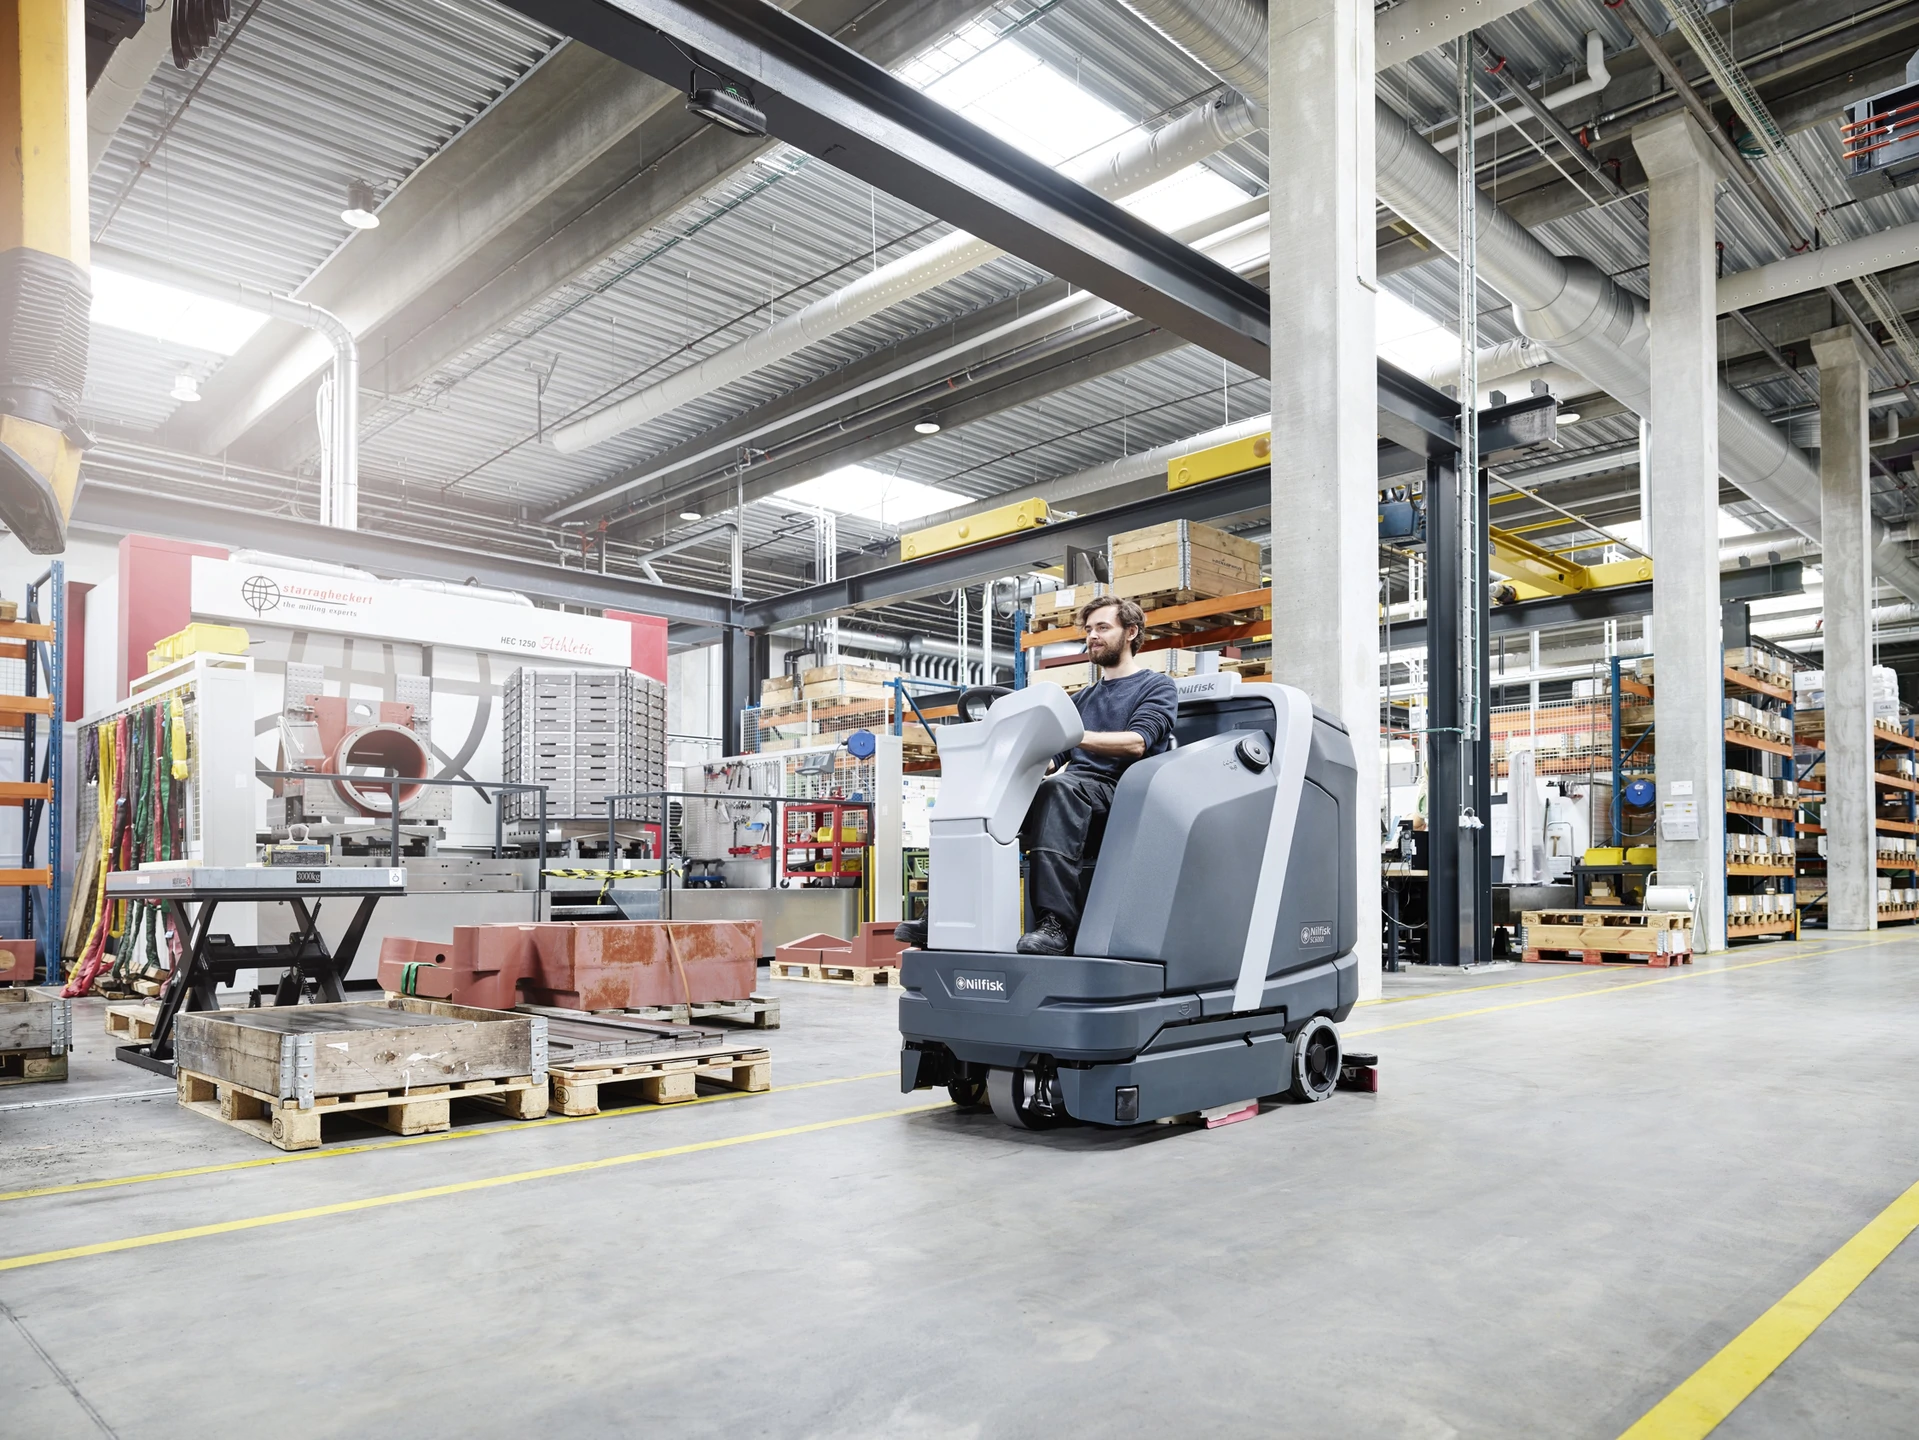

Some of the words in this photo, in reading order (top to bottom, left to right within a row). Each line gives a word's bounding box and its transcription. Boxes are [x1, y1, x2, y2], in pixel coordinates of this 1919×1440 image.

[283, 584, 373, 604] starragheckert
[283, 601, 296, 609] the
[299, 604, 326, 614] milling
[329, 608, 358, 617] experts
[500, 636, 516, 646] HEC
[519, 639, 537, 648] 1250
[540, 636, 594, 656] Athletic
[1178, 683, 1215, 694] Nilfisk
[297, 872, 321, 882] 3000kg
[1310, 926, 1331, 936] Nilfisk
[965, 978, 1004, 991] Nilfisk
